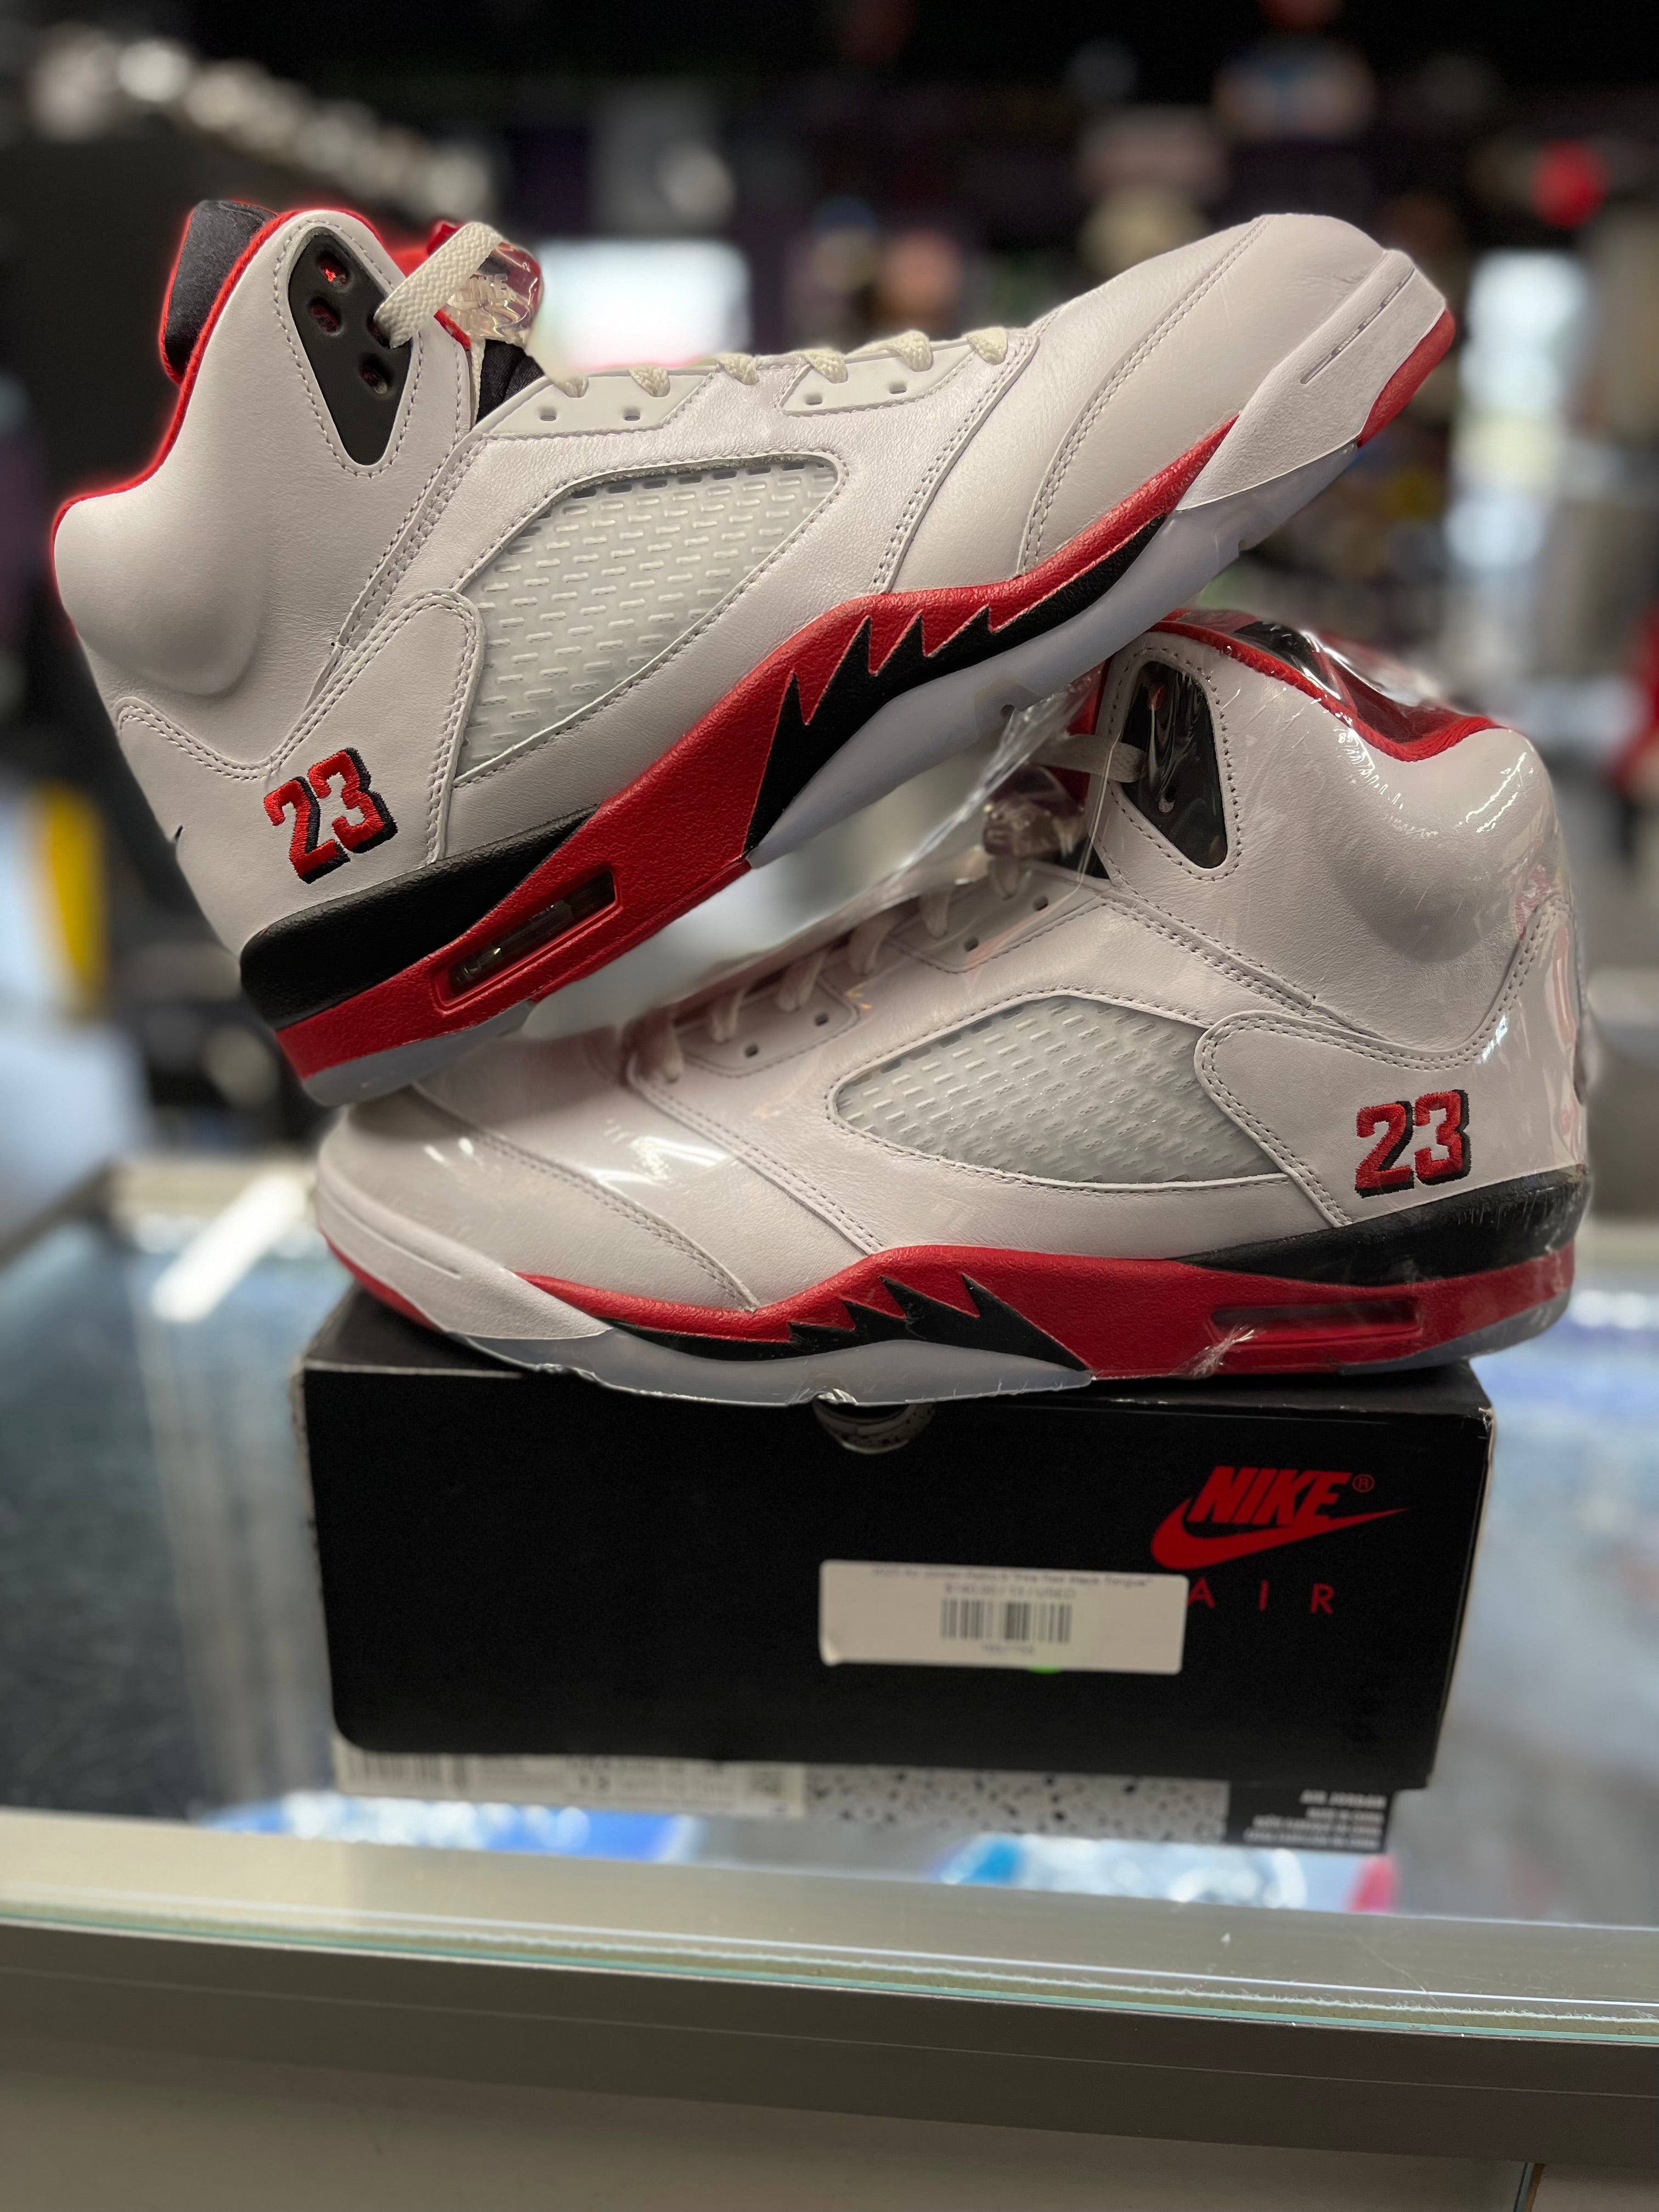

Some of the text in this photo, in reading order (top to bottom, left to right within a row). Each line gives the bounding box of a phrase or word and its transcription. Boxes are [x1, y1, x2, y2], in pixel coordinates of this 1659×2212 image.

[264, 747, 398, 884] 23
[1355, 1089, 1471, 1199] 23
[1187, 1465, 1352, 1526] NIKE
[1187, 1576, 1335, 1615] AIR
